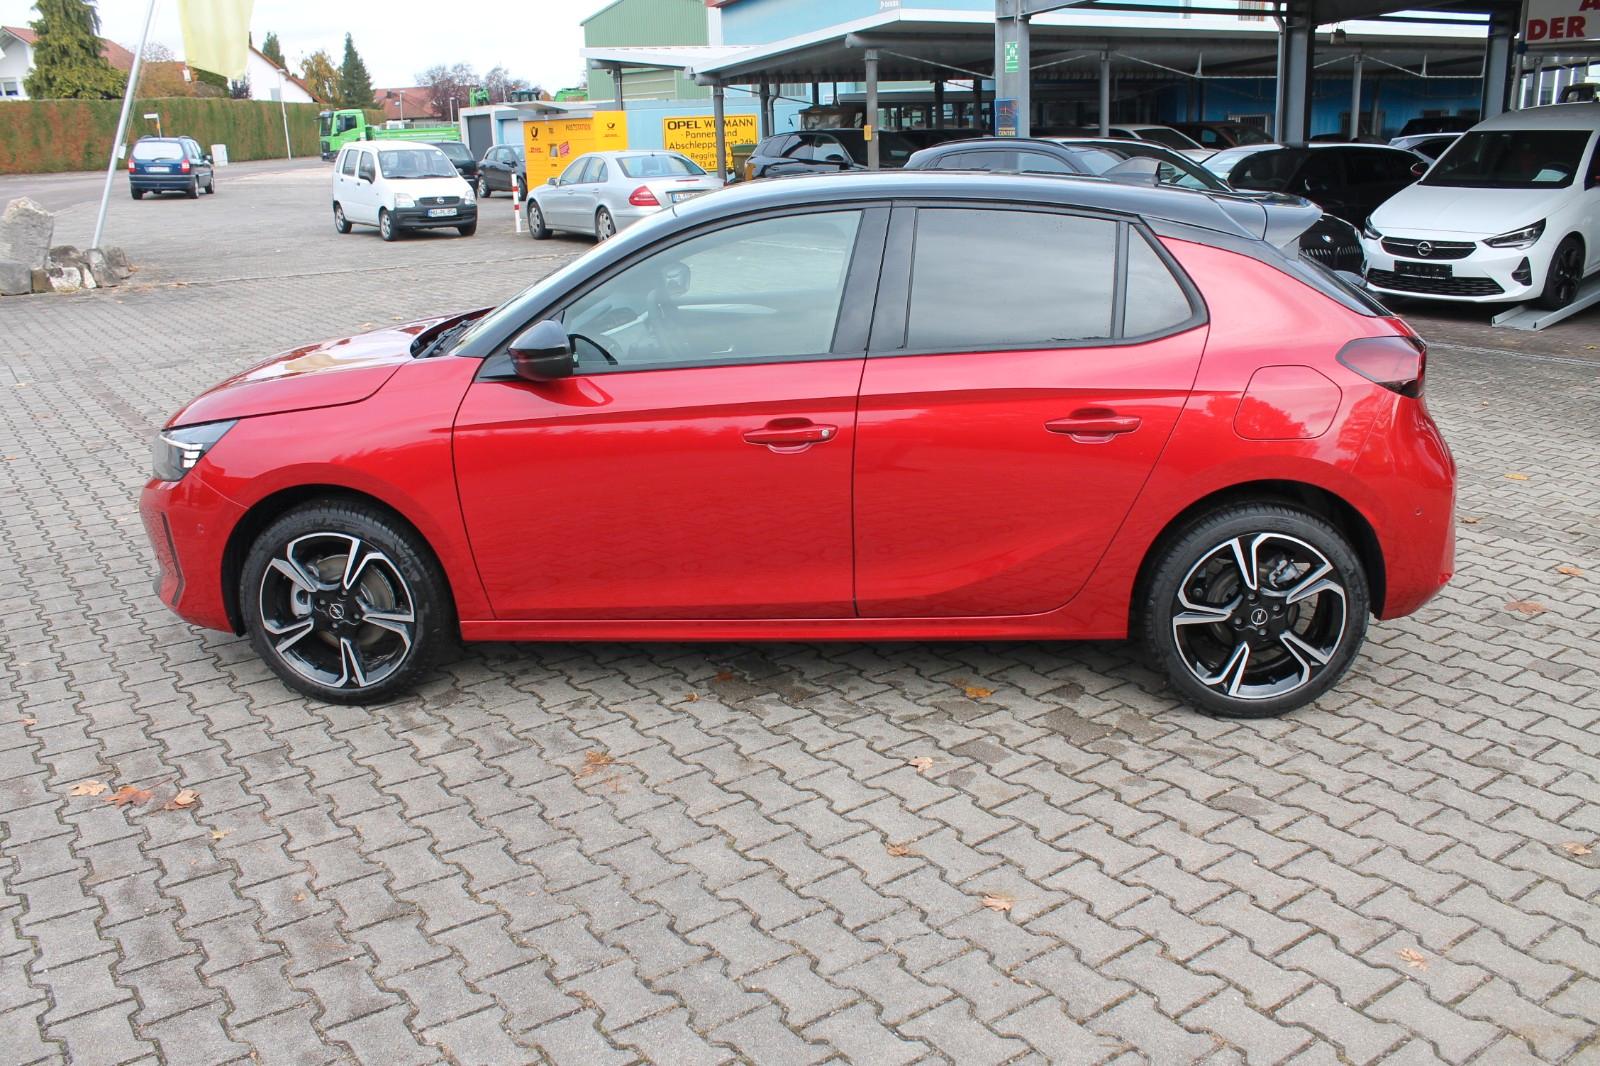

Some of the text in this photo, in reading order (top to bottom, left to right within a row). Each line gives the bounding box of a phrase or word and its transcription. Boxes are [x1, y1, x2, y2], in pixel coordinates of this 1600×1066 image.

[1527, 16, 1585, 40] DER
[667, 118, 753, 130] OPEL WIMANN
